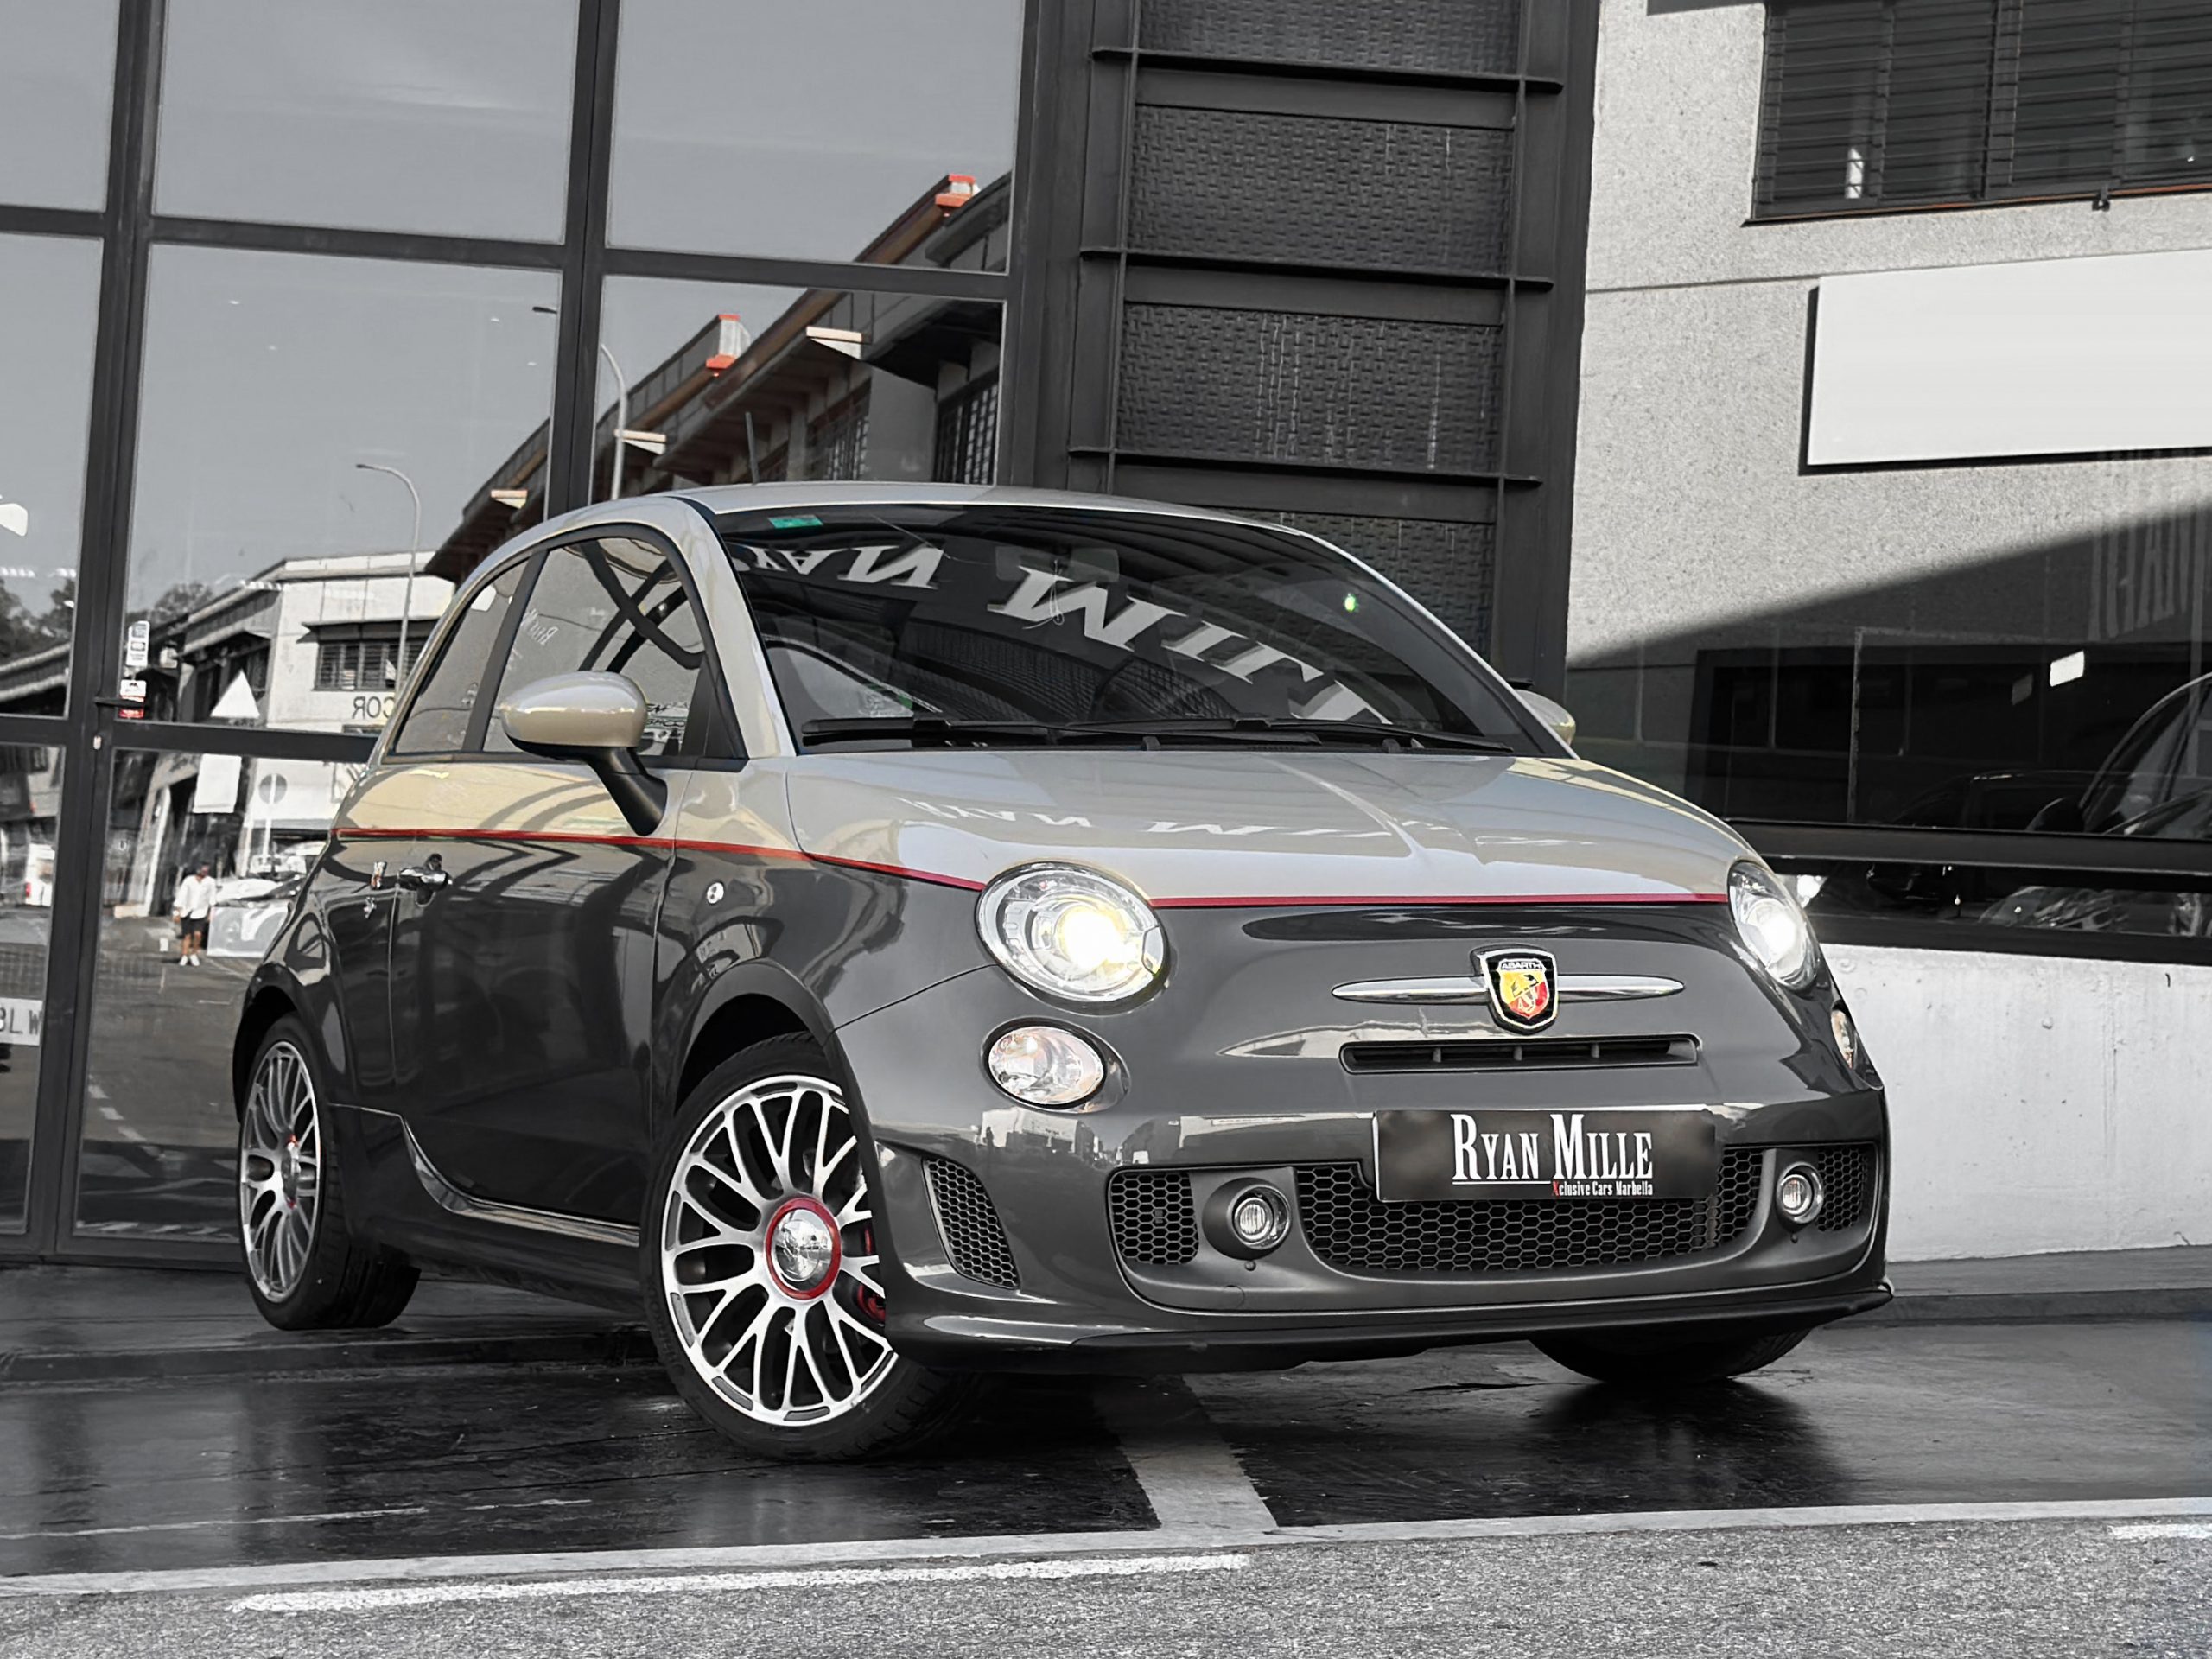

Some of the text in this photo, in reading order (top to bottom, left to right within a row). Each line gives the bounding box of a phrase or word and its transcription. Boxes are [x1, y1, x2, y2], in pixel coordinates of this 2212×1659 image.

[1450, 1114, 1653, 1180] RYAN MILLE
[1592, 1180, 1613, 1196] Cars
[1616, 1180, 1653, 1196] Marbella
